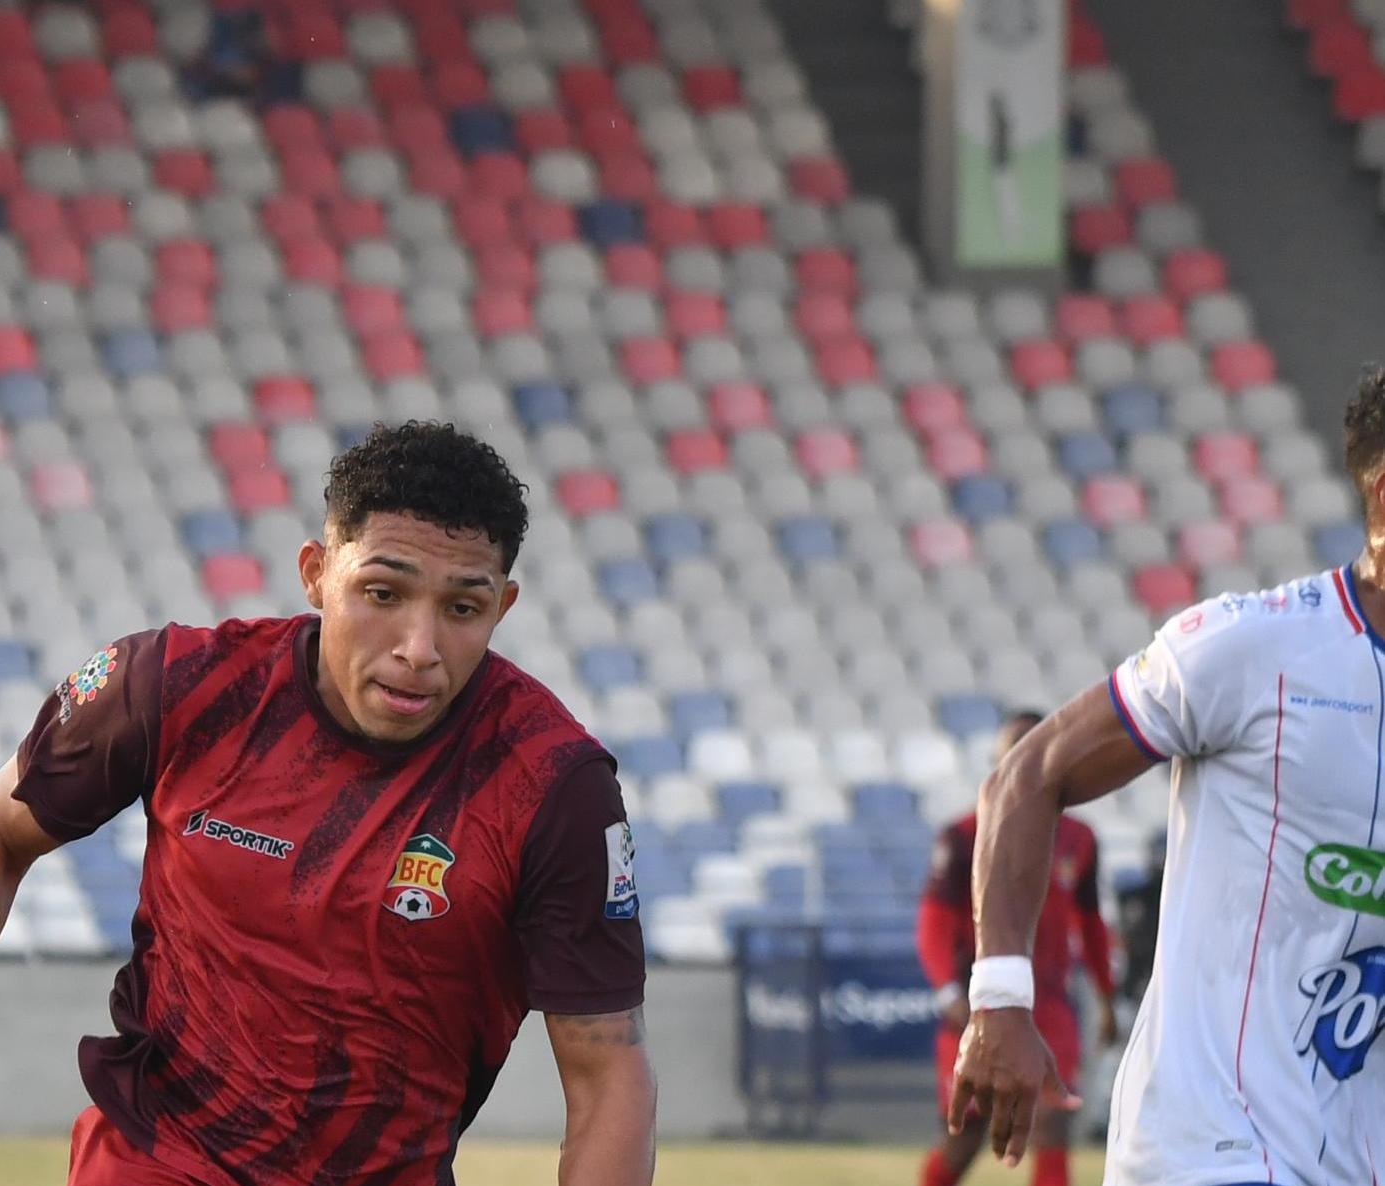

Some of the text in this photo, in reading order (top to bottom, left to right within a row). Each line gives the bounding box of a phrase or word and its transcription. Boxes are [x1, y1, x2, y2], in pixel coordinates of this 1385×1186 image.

[1311, 695, 1374, 716] aerosport
[204, 819, 289, 859] SPORTIK
[398, 856, 443, 887] BFC
